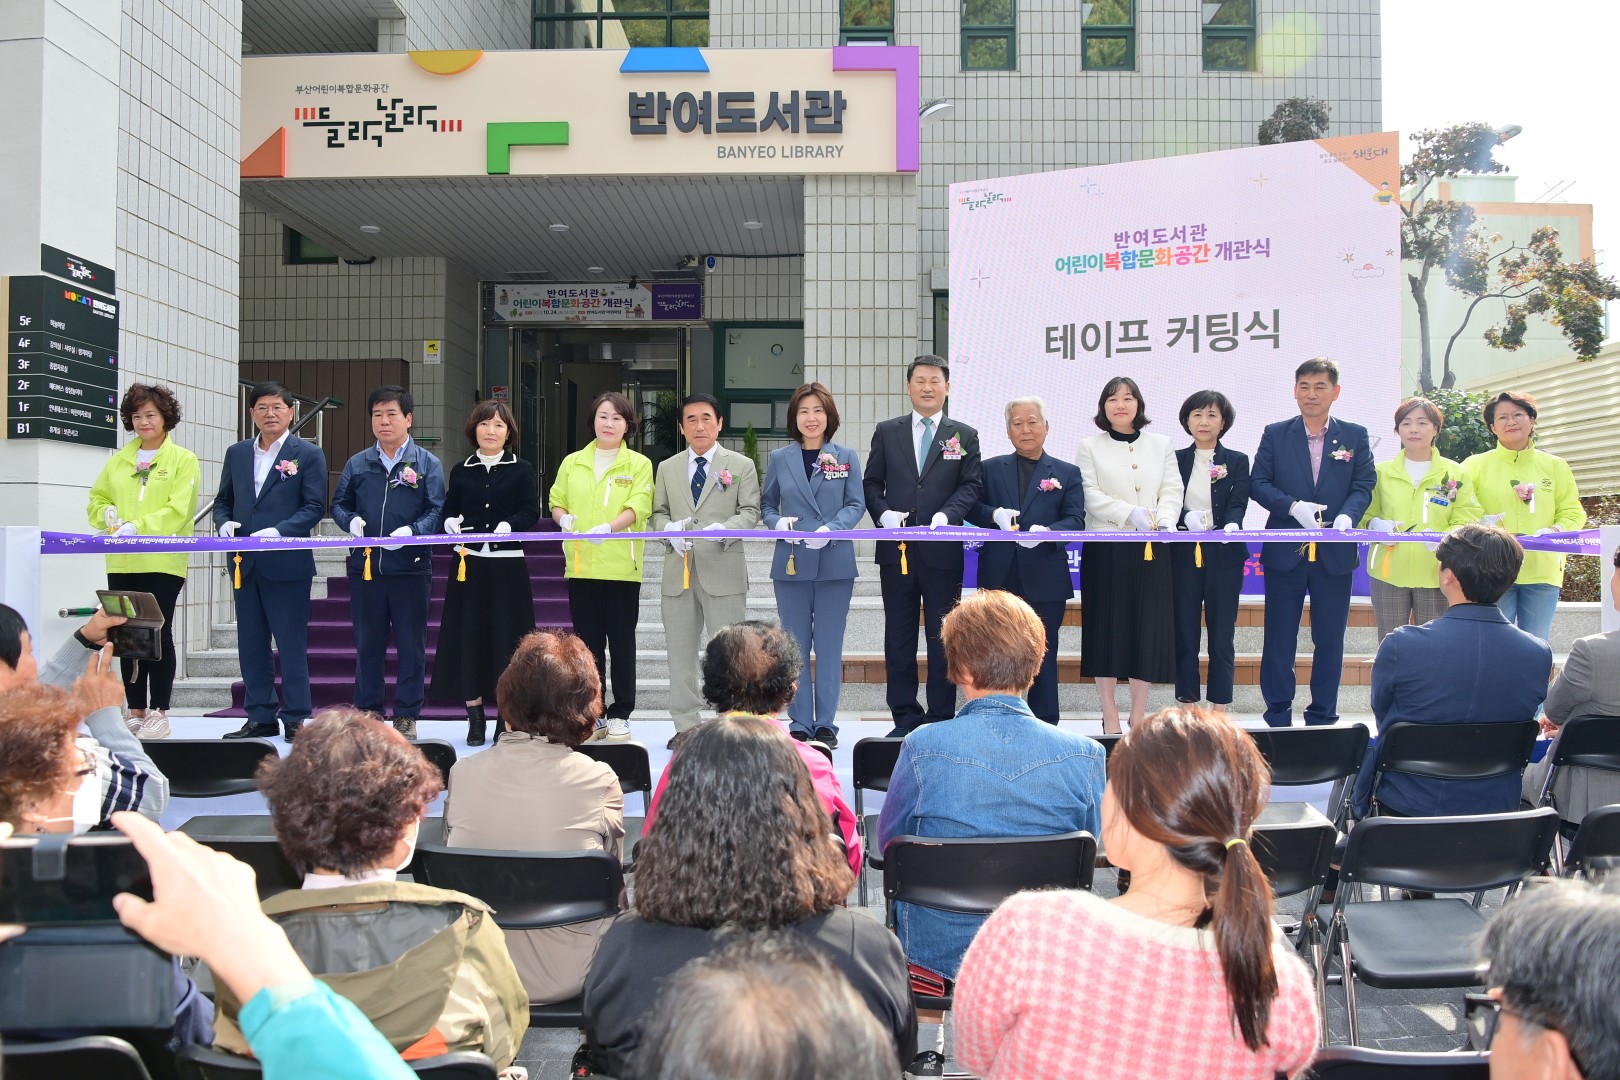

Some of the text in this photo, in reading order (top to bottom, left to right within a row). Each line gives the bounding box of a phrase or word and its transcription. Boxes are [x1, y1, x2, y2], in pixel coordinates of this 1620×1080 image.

[294, 83, 390, 95] 부산어린이복합문화공간
[628, 90, 848, 135] 반여도서관
[717, 145, 845, 159] BANYEO LIBRARY
[1113, 223, 1208, 250] 반여도서관
[1054, 237, 1272, 275] 어린이복합문화공간 개관식
[546, 288, 600, 299] 반여도서관
[512, 297, 633, 309] 어린이복합문화공간 개관식
[19, 316, 32, 326] 5F
[1044, 308, 1281, 361] 테이프 커팅식
[18, 337, 31, 348] 4F
[18, 359, 30, 370] 3F
[17, 380, 30, 390] 2F
[18, 401, 30, 412] 1F
[17, 423, 30, 433] B1
